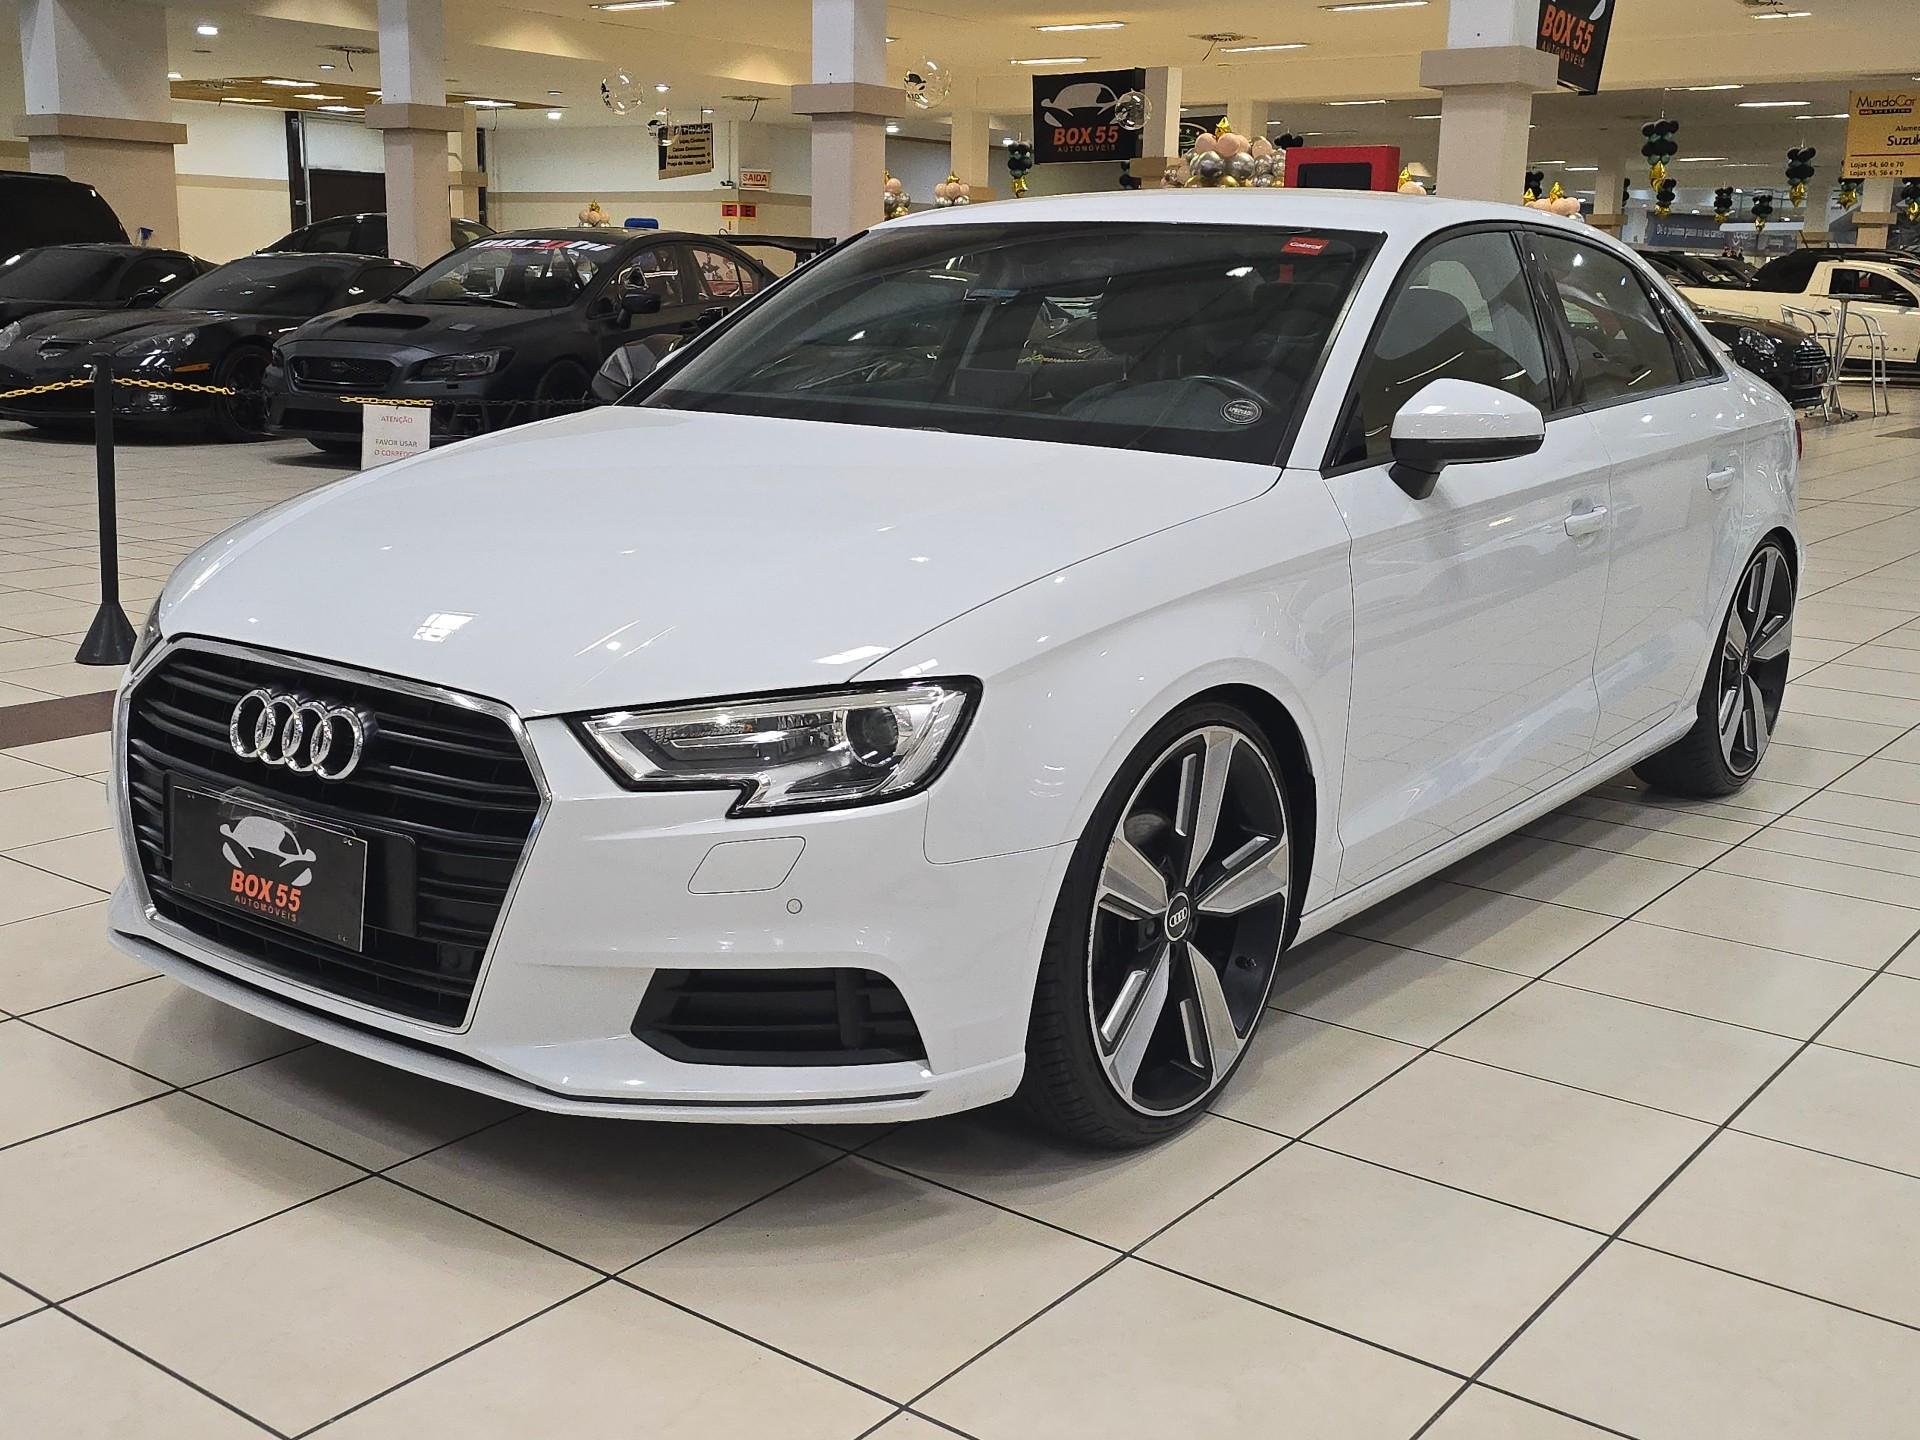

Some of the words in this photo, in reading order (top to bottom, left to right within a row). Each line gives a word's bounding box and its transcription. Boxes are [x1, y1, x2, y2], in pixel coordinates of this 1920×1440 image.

[1541, 4, 1577, 47] BOX
[1573, 19, 1595, 54] 55
[1856, 95, 1917, 108] MundoCar
[1053, 127, 1092, 145] BOX
[1095, 125, 1119, 144] 55
[1850, 162, 1868, 170] Lojas
[1849, 170, 1867, 178] Lojas
[381, 415, 413, 424] ATENÇÃO
[375, 438, 397, 446] FAVOR
[399, 440, 418, 448] USAR
[231, 868, 274, 902] BOX
[275, 884, 302, 912] 55
